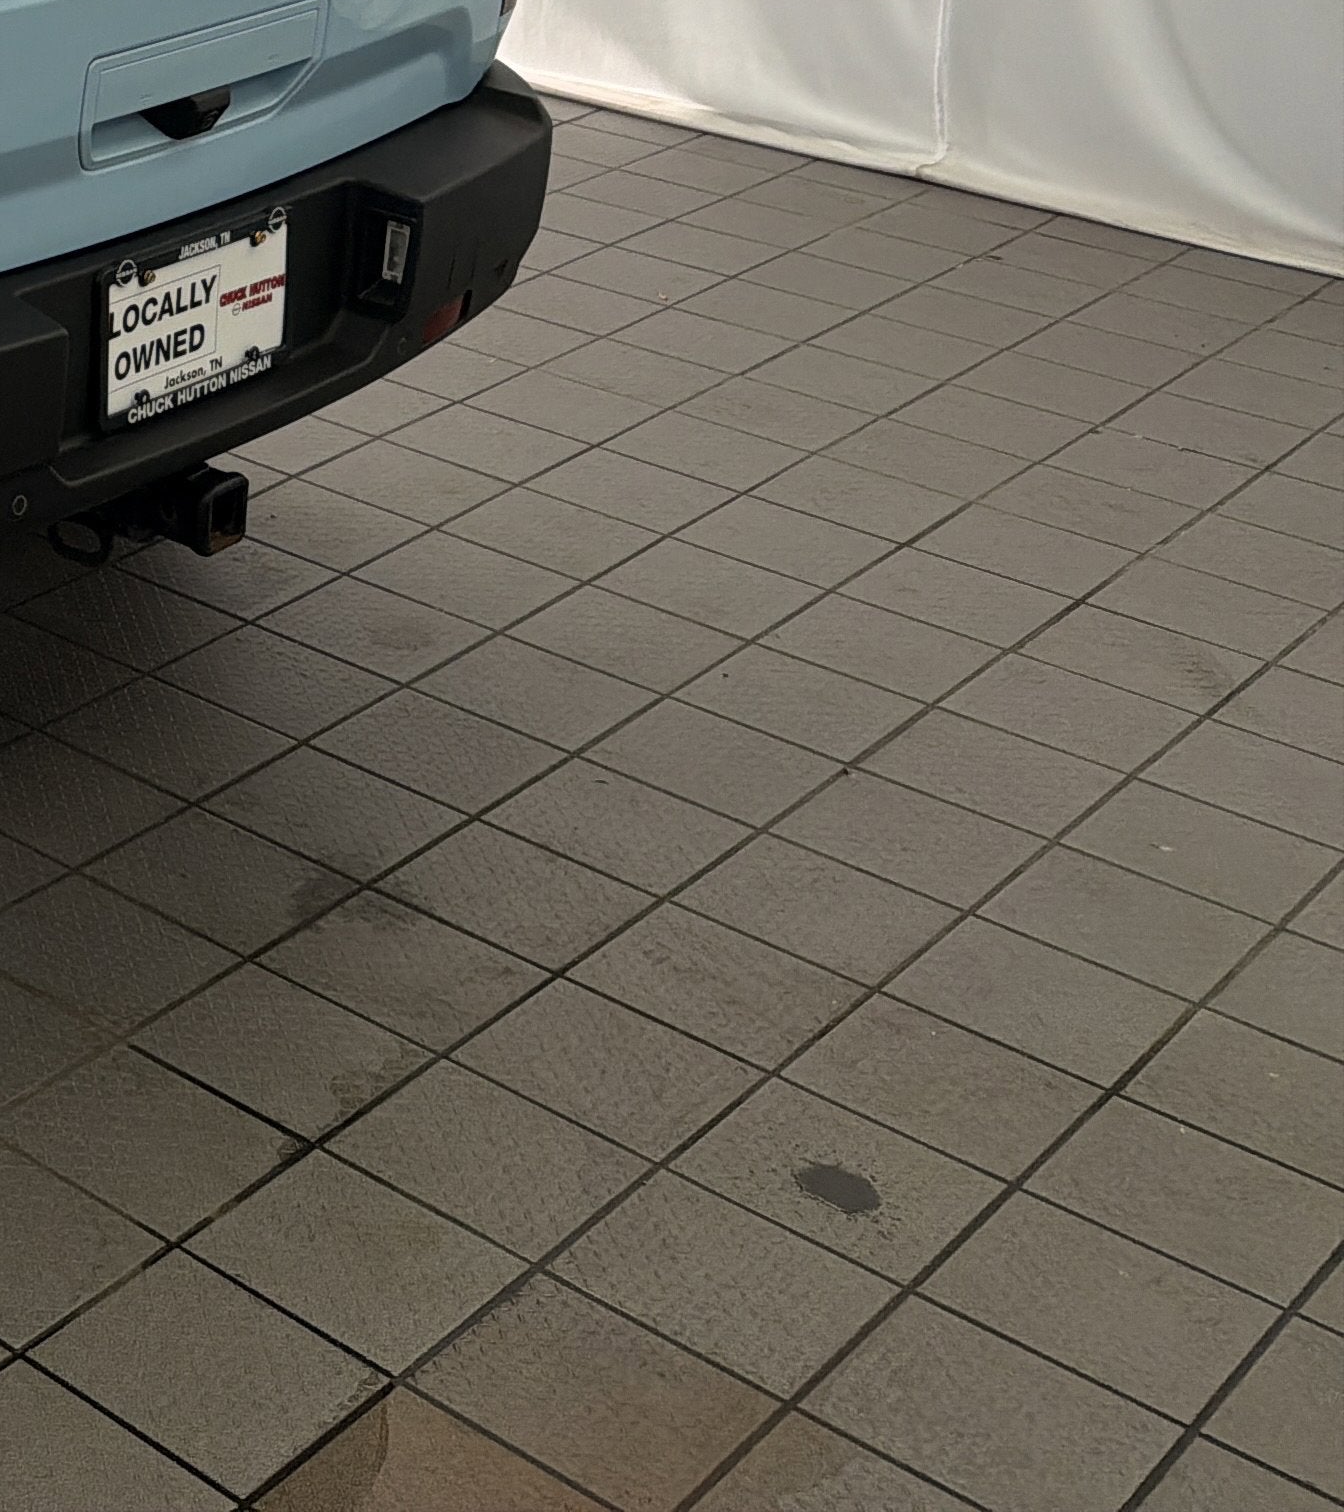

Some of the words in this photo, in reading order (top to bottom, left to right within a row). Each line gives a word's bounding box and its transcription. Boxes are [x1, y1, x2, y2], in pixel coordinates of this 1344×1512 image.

[178, 236, 219, 260] JACKSON,
[220, 230, 231, 244] TN
[109, 274, 217, 340] LOCALLY
[219, 285, 248, 308] CHUCK
[248, 273, 287, 297] HUTTON
[241, 292, 273, 312] NISSAN
[114, 323, 206, 381] OWNED
[127, 397, 174, 424] CHUCK
[177, 374, 227, 405] HUTTON
[229, 354, 272, 383] NISSAN
[163, 368, 207, 390] Jackson,
[209, 355, 223, 371] TN
